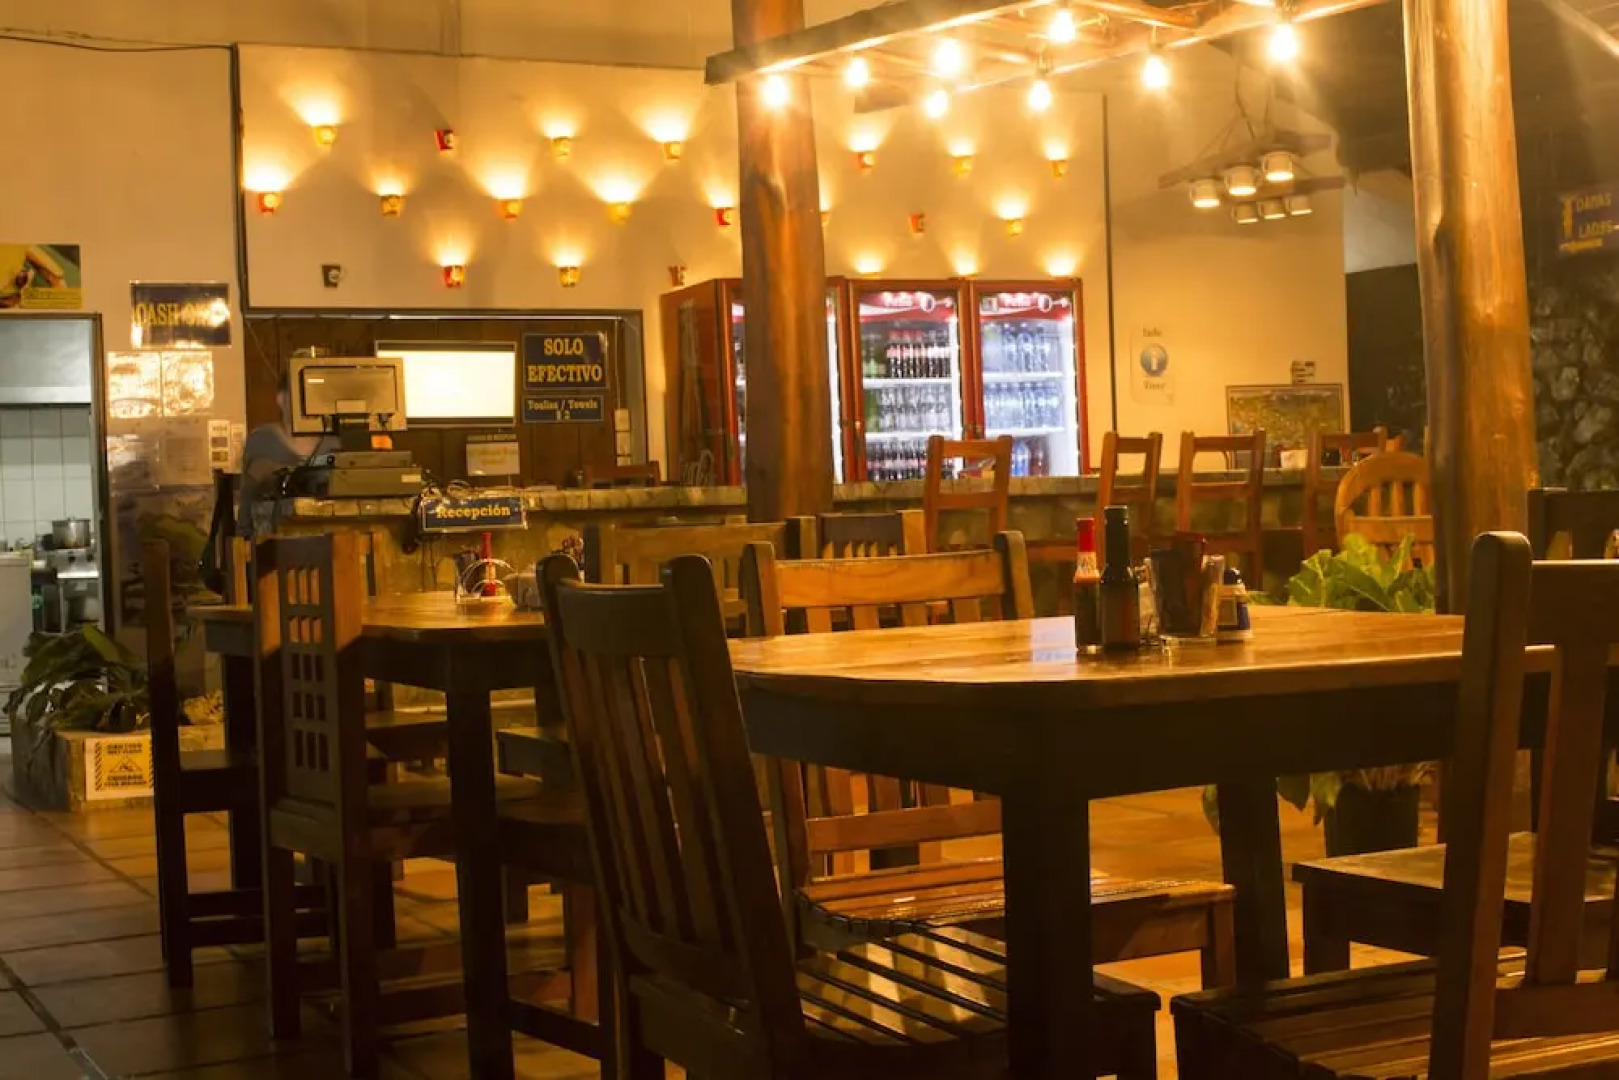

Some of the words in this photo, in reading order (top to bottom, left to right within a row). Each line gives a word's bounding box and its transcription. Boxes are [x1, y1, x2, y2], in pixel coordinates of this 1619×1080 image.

[543, 338, 583, 356] SOLO
[527, 364, 602, 382] EFECTIVO
[435, 504, 511, 521] Recepción
